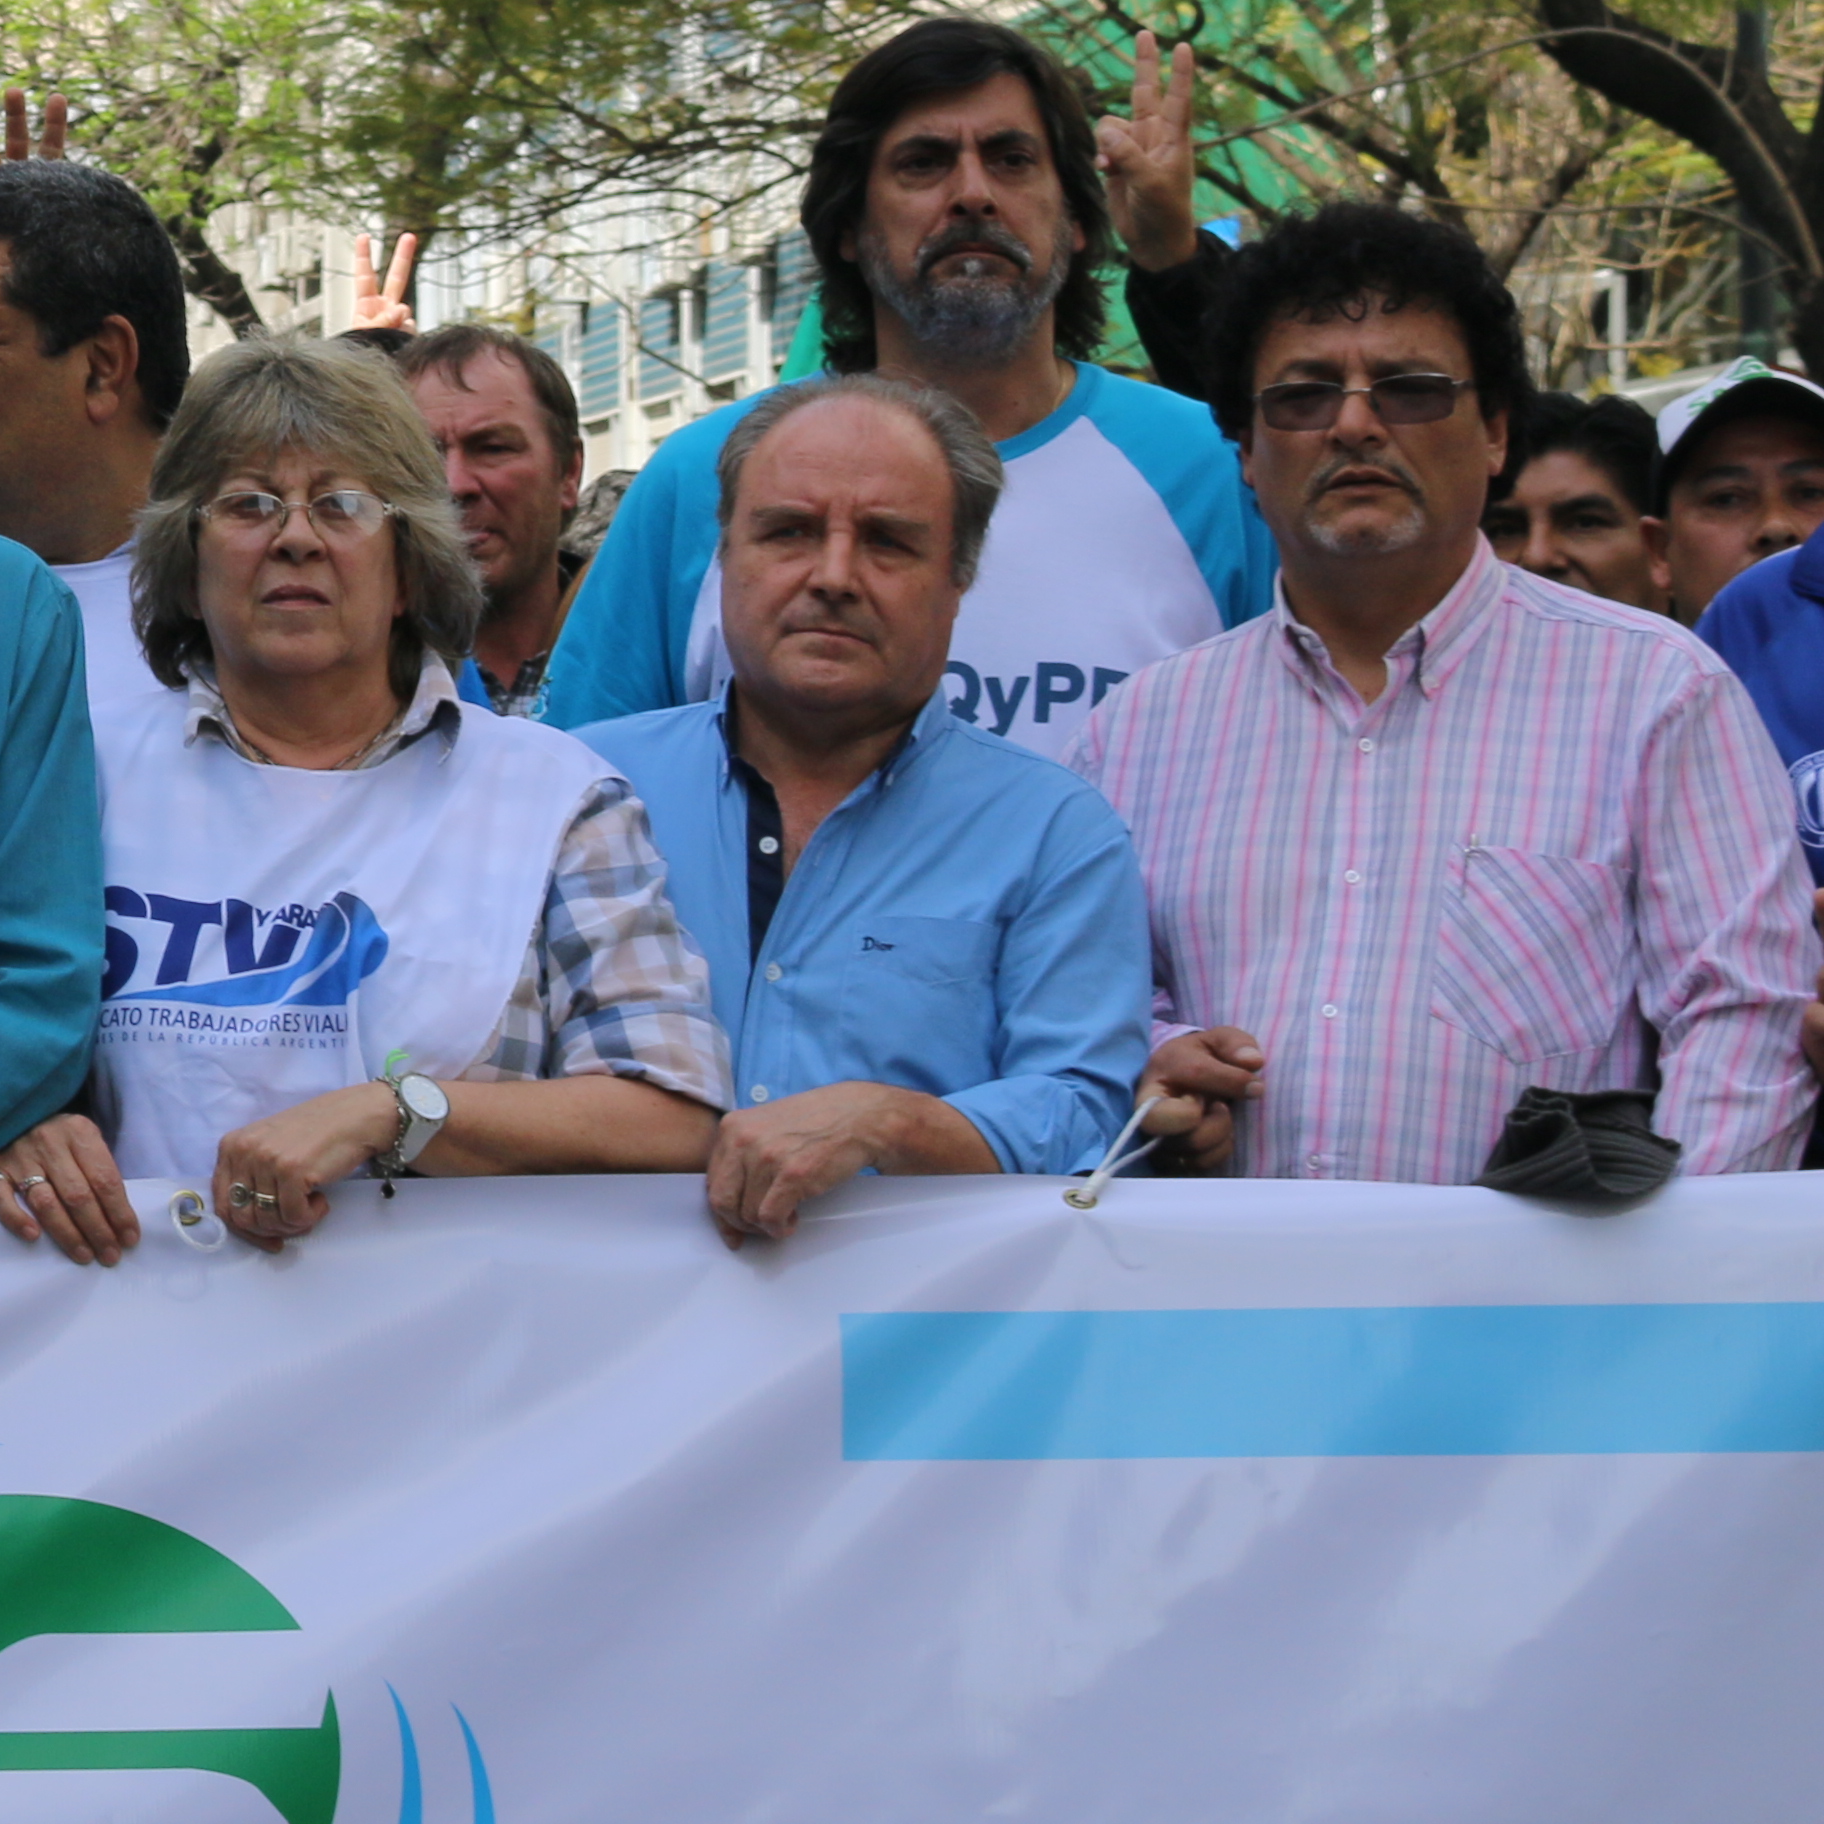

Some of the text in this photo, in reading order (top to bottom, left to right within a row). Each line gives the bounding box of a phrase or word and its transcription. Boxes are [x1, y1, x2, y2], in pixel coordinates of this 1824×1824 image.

[149, 1007, 301, 1034] TRABAJADORES
[122, 1031, 138, 1042] DE
[149, 1032, 165, 1042] LA
